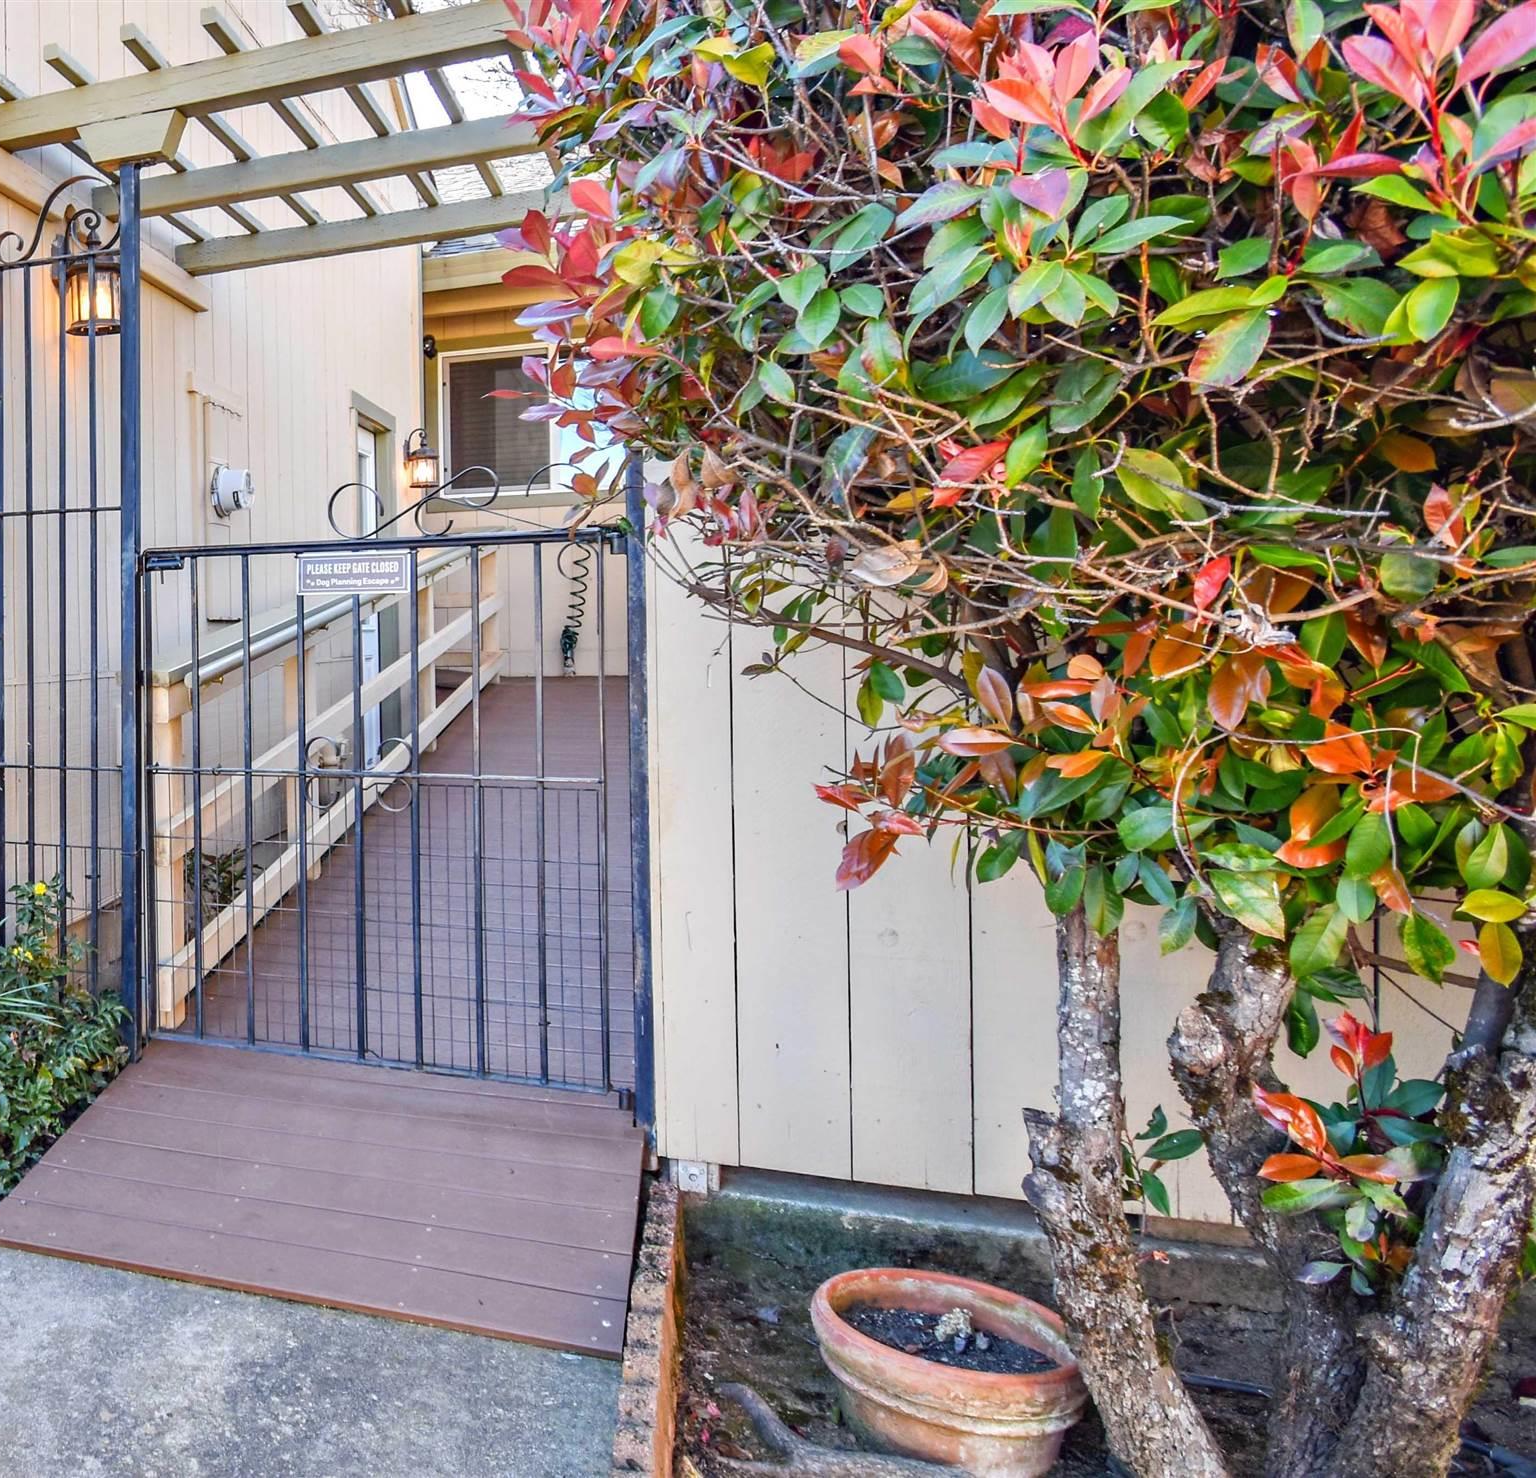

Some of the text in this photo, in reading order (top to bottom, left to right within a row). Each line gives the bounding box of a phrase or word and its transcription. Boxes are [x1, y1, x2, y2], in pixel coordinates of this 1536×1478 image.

[307, 561, 399, 575] PLEASE KEEP GATE CLOSED
[316, 577, 389, 587] Dog Planning Escape
